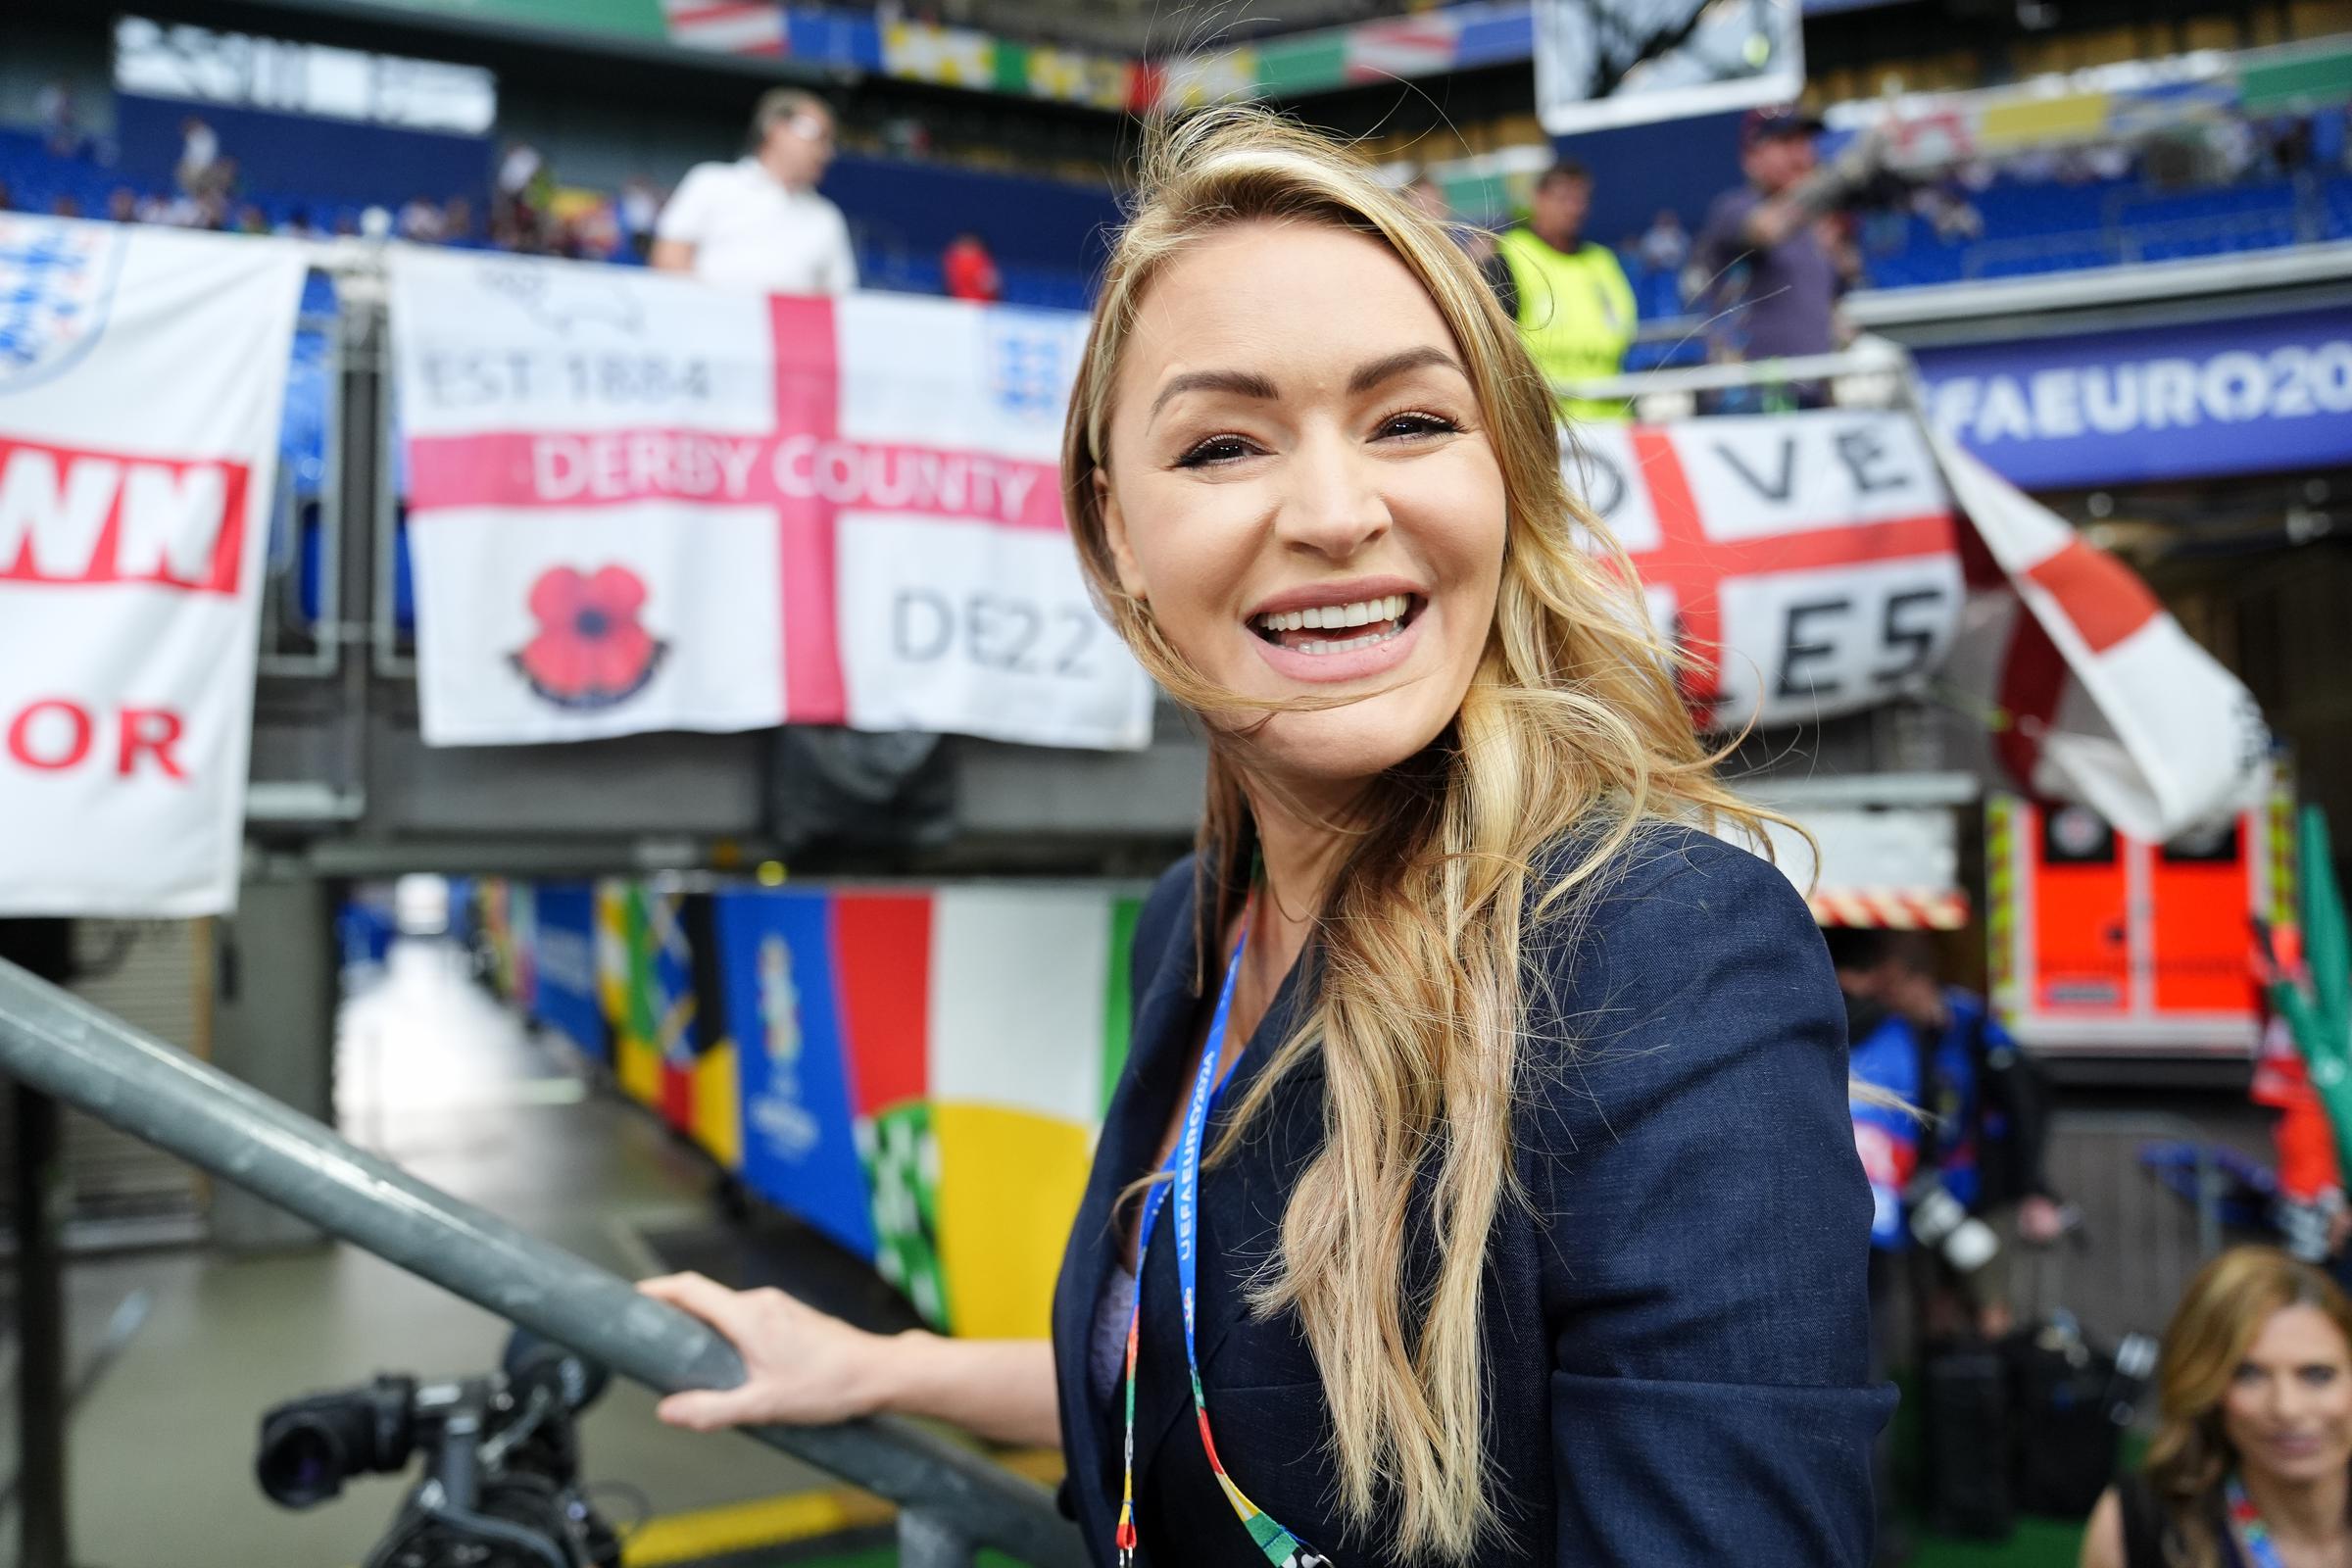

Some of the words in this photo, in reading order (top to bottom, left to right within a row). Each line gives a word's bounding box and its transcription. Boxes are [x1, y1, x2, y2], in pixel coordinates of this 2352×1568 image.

[419, 348, 534, 409] EST
[564, 350, 712, 405] 1884
[532, 432, 762, 501] DERBY
[772, 433, 1041, 521] COUNTY
[891, 588, 1098, 680] DE22
[7, 700, 190, 781] OR
